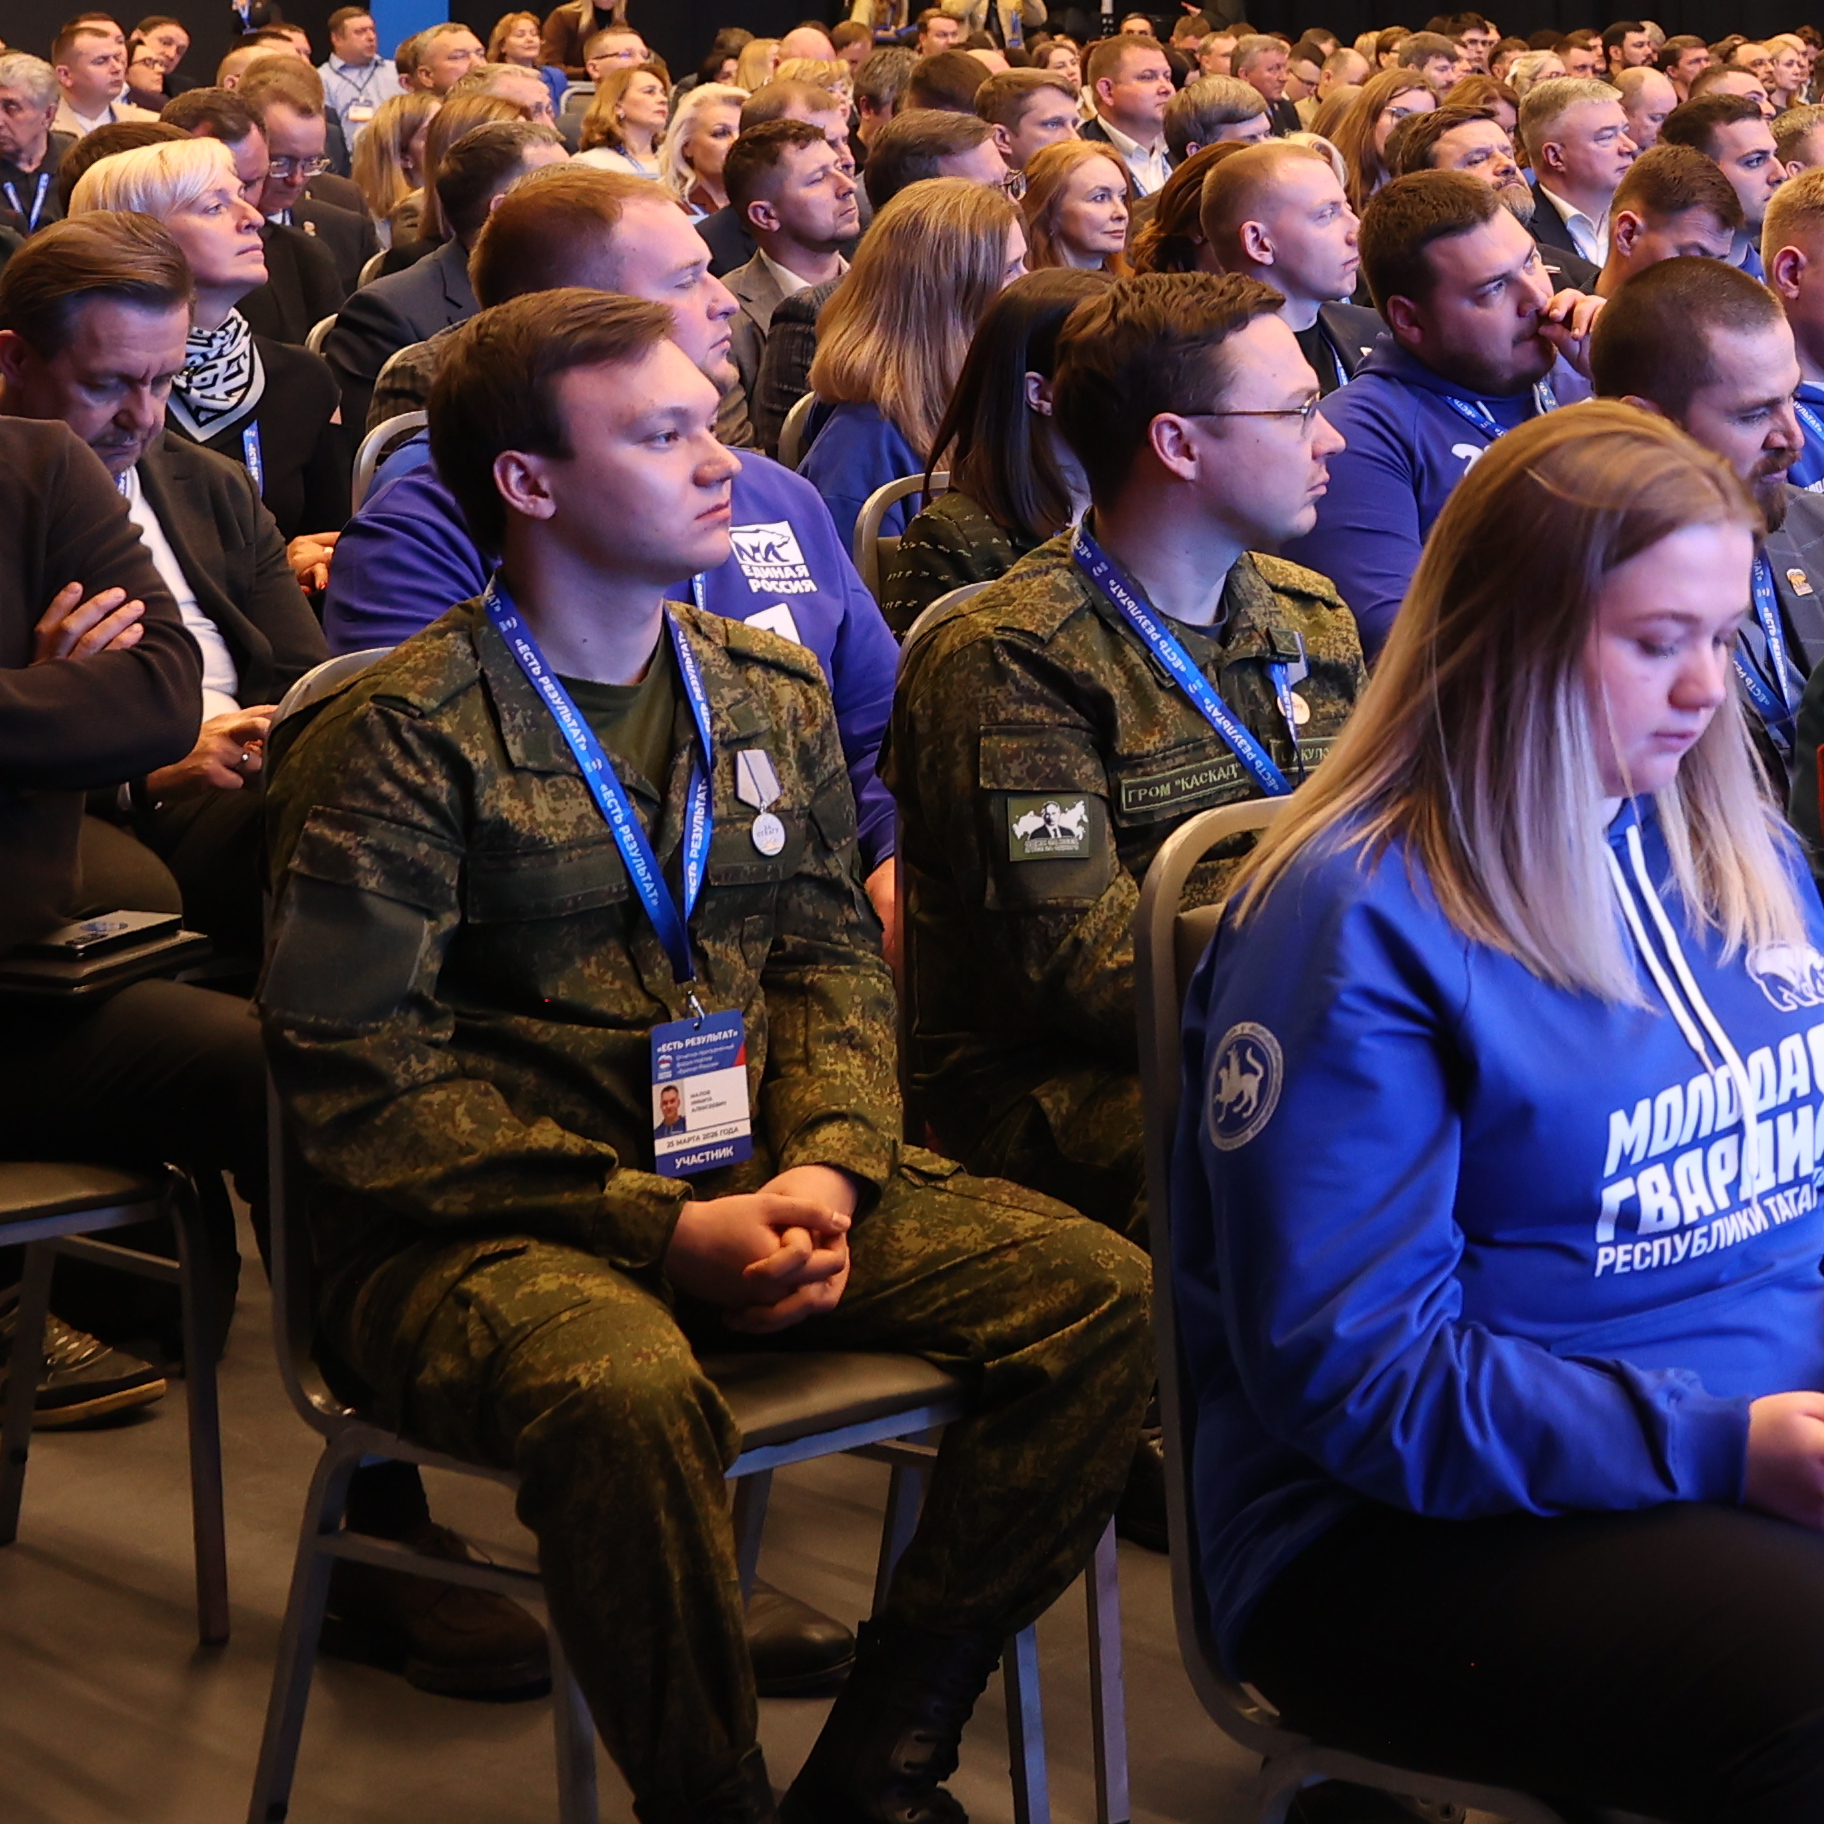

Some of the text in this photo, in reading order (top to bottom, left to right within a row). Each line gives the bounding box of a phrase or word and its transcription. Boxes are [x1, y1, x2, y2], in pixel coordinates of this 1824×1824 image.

[740, 564, 811, 579] ЕДИНАЯ
[747, 578, 818, 594] РОССИЯ
[1107, 578, 1188, 673] «ЕСТЬ РЕЗУЛЬТАТ»
[514, 638, 588, 752] «ЕСТЬ РЕЗУЛЬТАТ»
[1202, 696, 1281, 793] «ЕСТЬ РЕЗУЛЬТАТ»
[1126, 780, 1172, 804] ГРОМ
[600, 783, 660, 907] «ЕСТЬ РЕЗУЛЬТАТ»
[657, 1028, 740, 1054] «ЕСТЬ РЕЗУЛЬТАТ»
[676, 1134, 701, 1146] МАРТА
[719, 1126, 740, 1138] ГОДА
[674, 1145, 735, 1169] УЧАСТНИК
[1594, 1202, 1770, 1278] РЕСПУБЛИКИ
